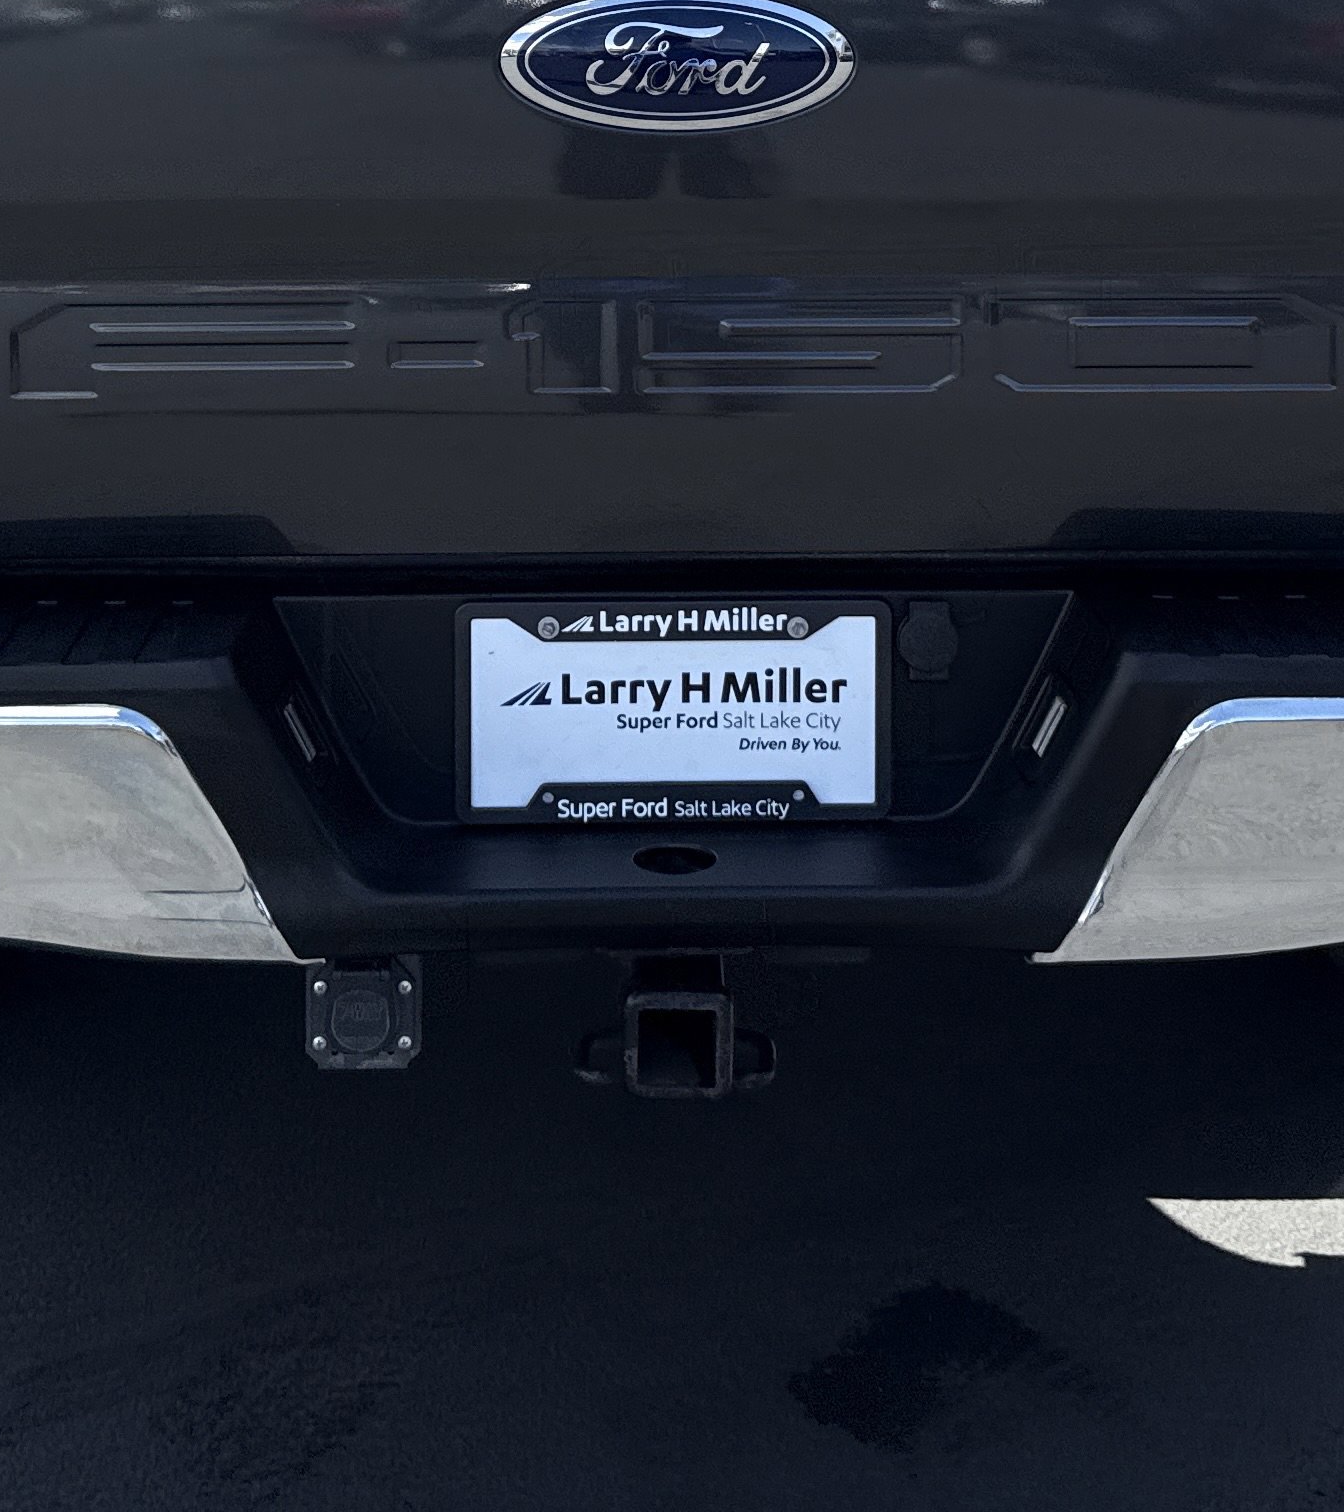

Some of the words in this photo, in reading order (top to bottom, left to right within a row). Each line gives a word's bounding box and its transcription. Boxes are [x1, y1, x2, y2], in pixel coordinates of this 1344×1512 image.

[585, 21, 771, 96] Ford
[599, 610, 673, 637] Larry
[677, 610, 699, 632] H
[704, 607, 788, 632] Miller
[561, 673, 672, 711] Larry
[681, 671, 711, 703] H
[720, 668, 848, 703] Miller
[616, 713, 671, 733] Super
[676, 711, 718, 729] Ford
[723, 711, 755, 729] Salt
[760, 711, 801, 729] Lake
[806, 712, 841, 732] City
[739, 737, 787, 750] Driven
[792, 738, 810, 753] By
[557, 799, 616, 822] Super
[621, 797, 668, 817] Ford
[674, 800, 707, 817] Salt
[712, 800, 751, 816] Lake
[755, 798, 790, 820] City
